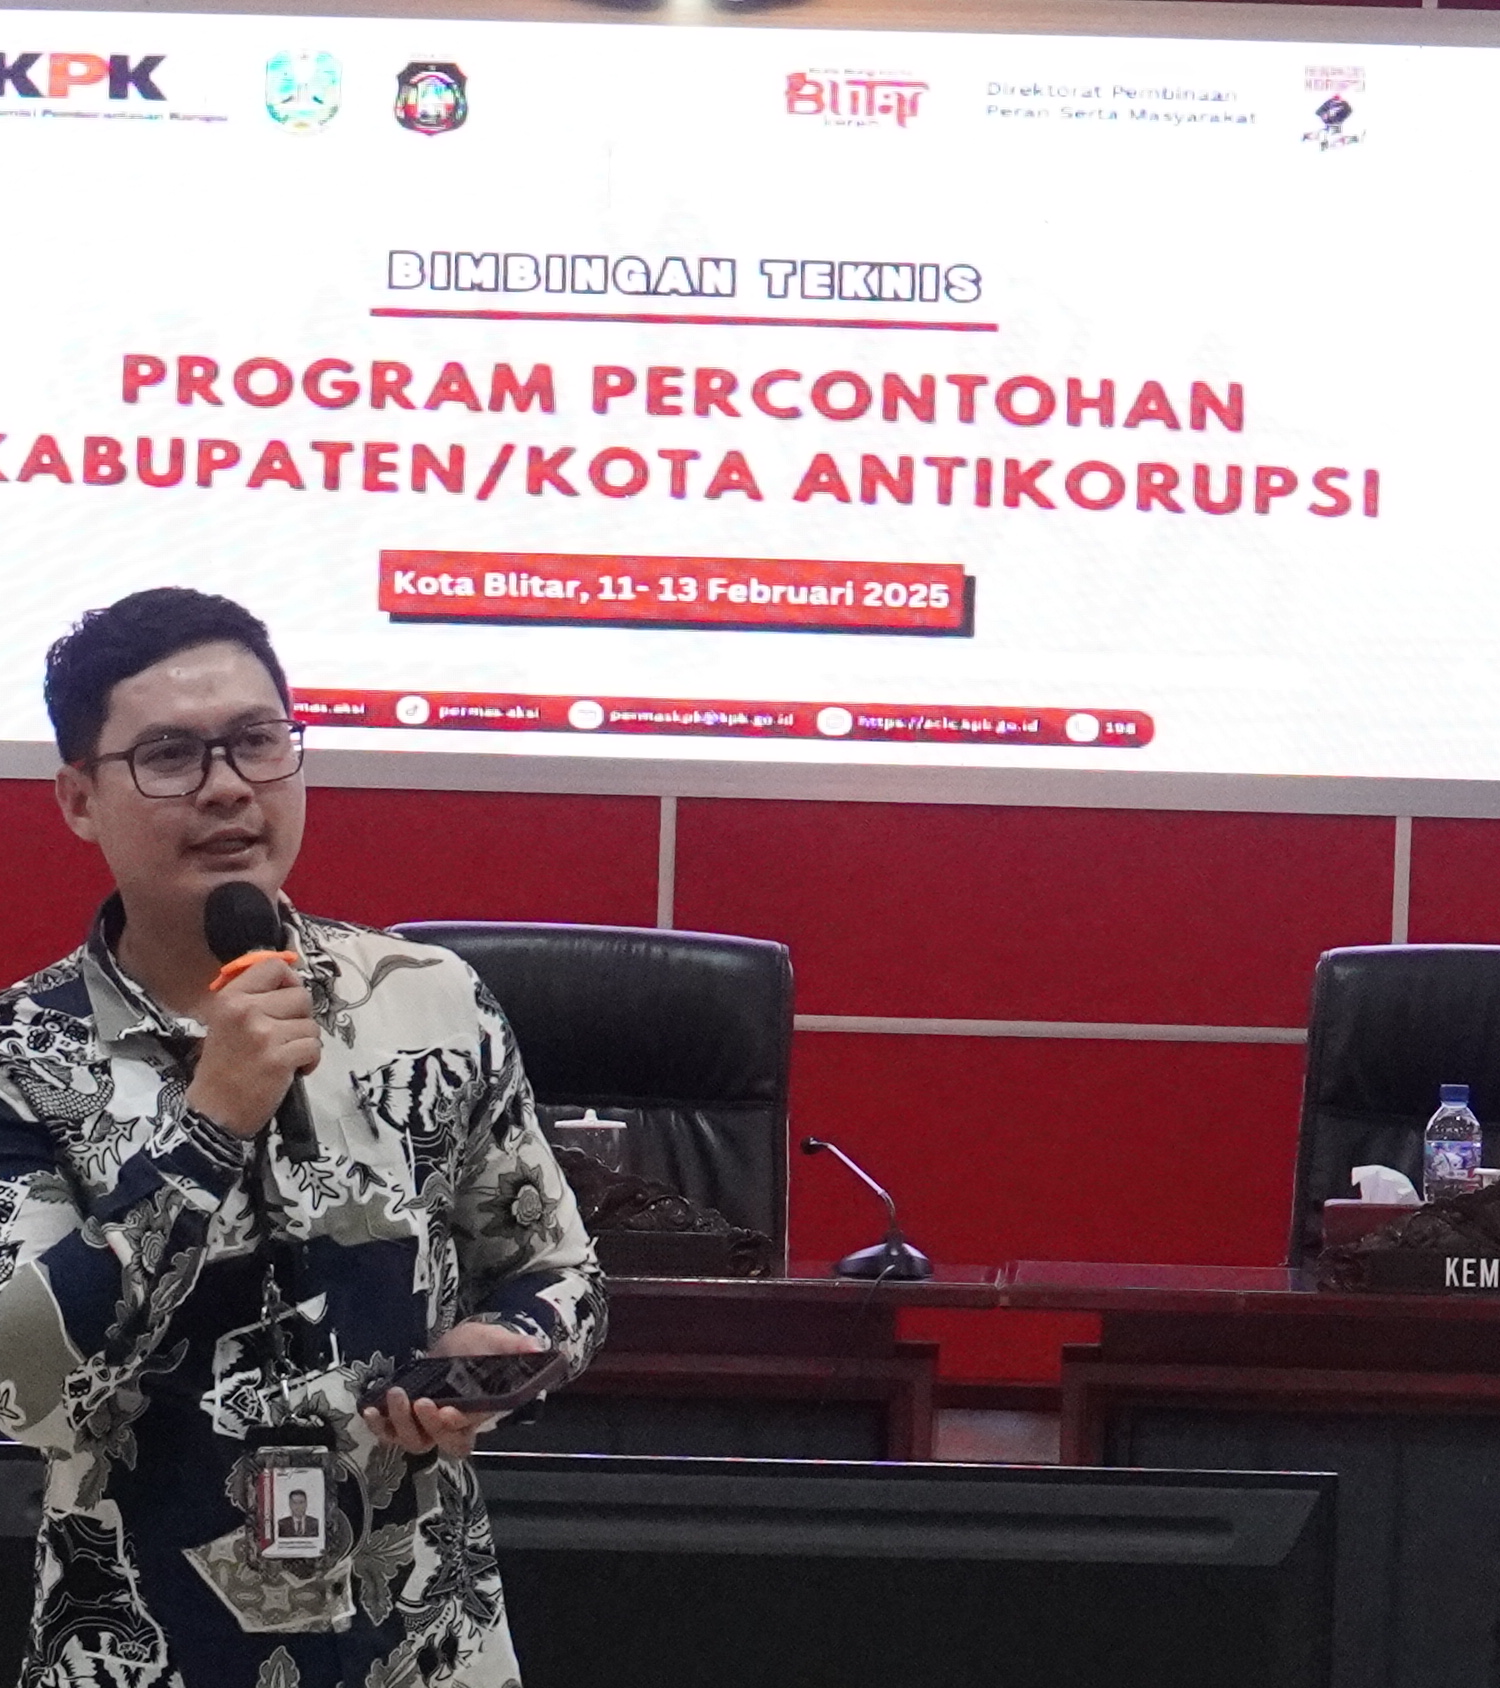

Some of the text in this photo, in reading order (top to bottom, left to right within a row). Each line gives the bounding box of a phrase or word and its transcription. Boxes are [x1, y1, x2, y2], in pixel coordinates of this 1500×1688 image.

[986, 104, 1257, 126] Peran Serta Masyarakat
[387, 250, 983, 304] BIMBINGAN TEKNIS
[121, 353, 1245, 432] PROGRAM PERCONTOHAN
[792, 453, 1381, 518] ANTIKORUPSI
[393, 569, 950, 610] Kota Blitar, 11- 13 Februari 2025
